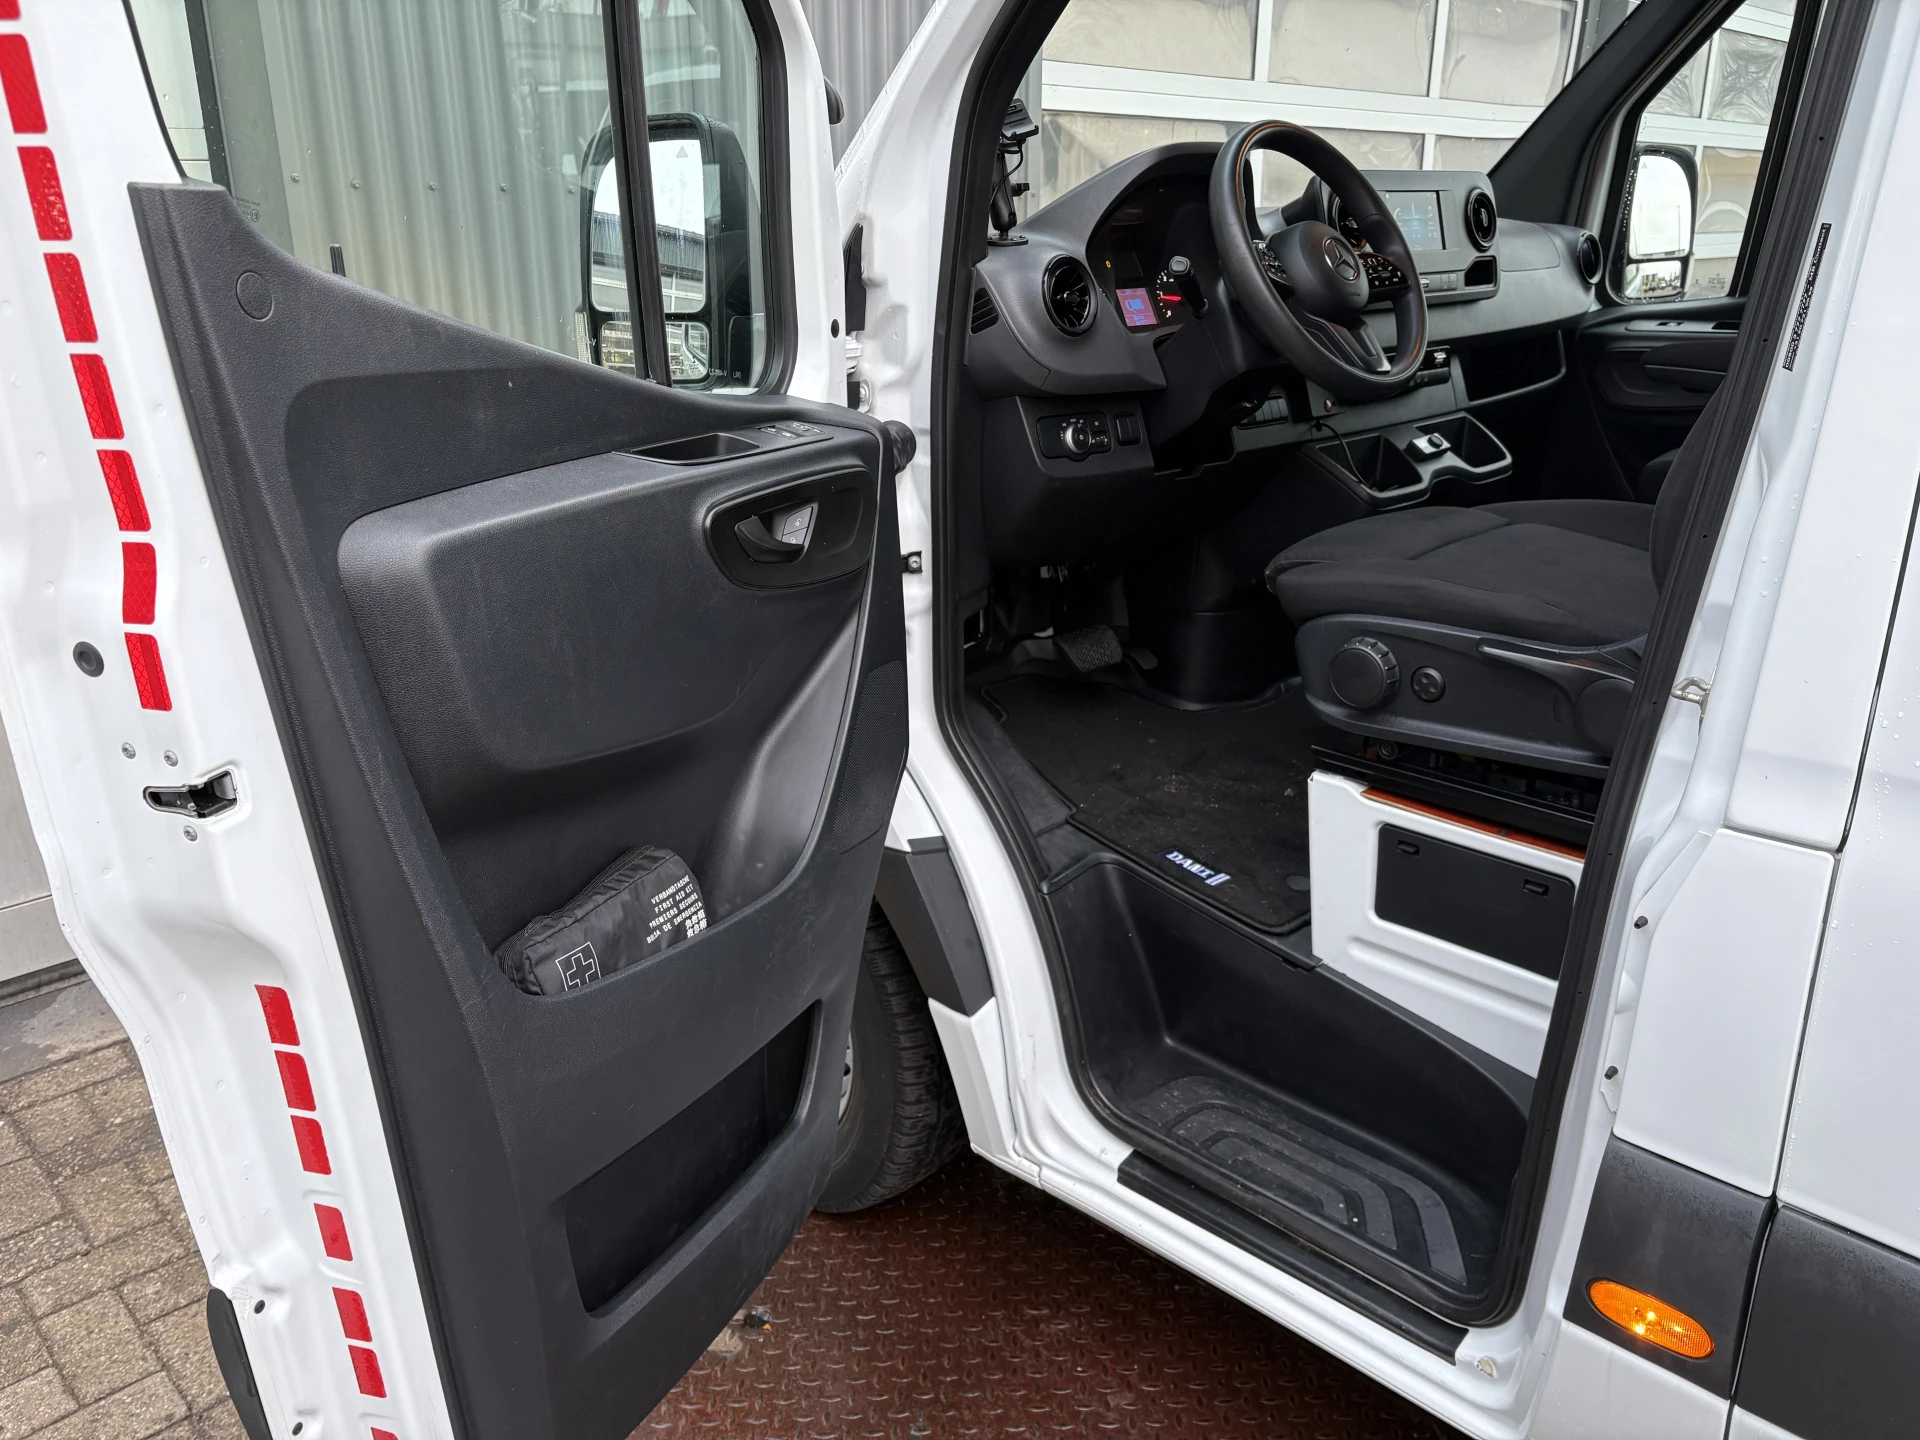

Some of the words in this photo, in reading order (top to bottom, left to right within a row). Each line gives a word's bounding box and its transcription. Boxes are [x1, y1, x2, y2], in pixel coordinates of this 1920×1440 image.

[654, 897, 674, 914] FIRST
[675, 890, 686, 902] AID
[649, 906, 679, 930] PREMIERS
[646, 929, 662, 944] BOLSA
[662, 922, 673, 932] DE
